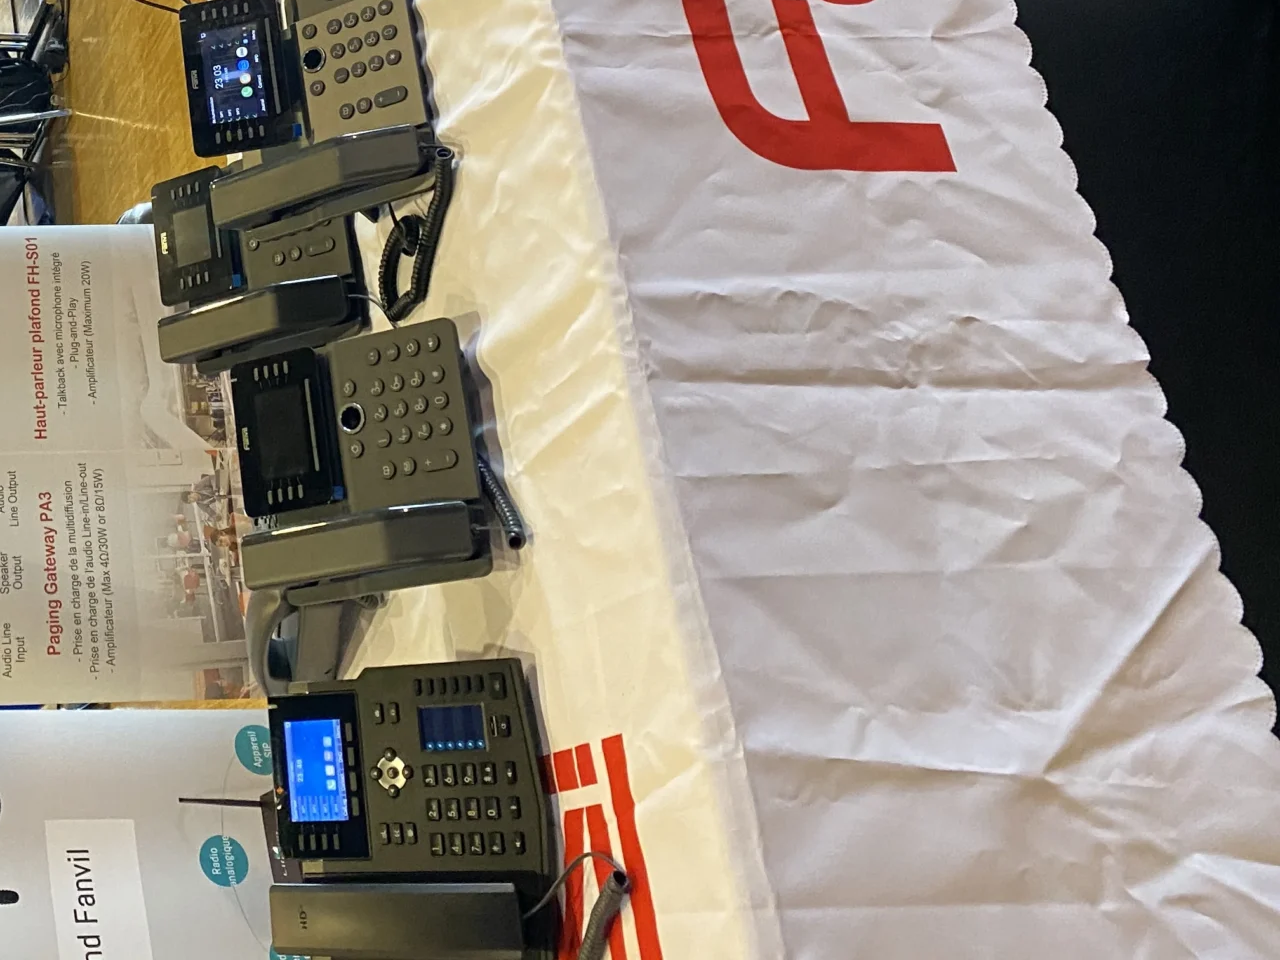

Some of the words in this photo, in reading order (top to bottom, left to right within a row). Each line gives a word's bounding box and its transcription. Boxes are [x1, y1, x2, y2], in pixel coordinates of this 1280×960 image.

[24, 237, 41, 285] FH-S01
[51, 252, 62, 283] intégré
[80, 260, 93, 286] 20W)
[27, 289, 45, 343] plafond
[52, 285, 66, 340] microphone
[82, 288, 95, 336] (Maximum
[67, 297, 81, 363] Plug-and-Play
[56, 342, 65, 364] avec
[85, 339, 99, 399] Amplificateur
[30, 346, 49, 440] Haut-parleur
[56, 367, 68, 409] Talkback
[7, 470, 20, 504] Output
[9, 506, 20, 527] Line
[38, 491, 53, 522] PA3
[63, 480, 77, 544] multidiffusion
[97, 513, 107, 525] or
[42, 526, 59, 595] Gateway
[68, 546, 78, 556] la
[68, 558, 79, 571] de
[0, 552, 11, 595] Speaker
[13, 555, 24, 590] Output
[85, 575, 96, 589] de
[101, 570, 114, 596] (Max
[70, 574, 82, 610] charge
[86, 591, 100, 627] charge
[1, 622, 12, 645] Line
[46, 599, 64, 655] Paging
[73, 612, 82, 626] en
[103, 598, 118, 666] Amplificateur
[16, 636, 28, 663] Input
[72, 628, 83, 655] Prise
[90, 630, 100, 644] en
[2, 647, 13, 678] Audio
[89, 646, 100, 673] Prise
[247, 730, 262, 768] Appareil
[262, 742, 272, 758] SIP
[209, 847, 222, 875] Radio
[221, 835, 237, 887] analogique
[66, 849, 98, 923] Fanvil
